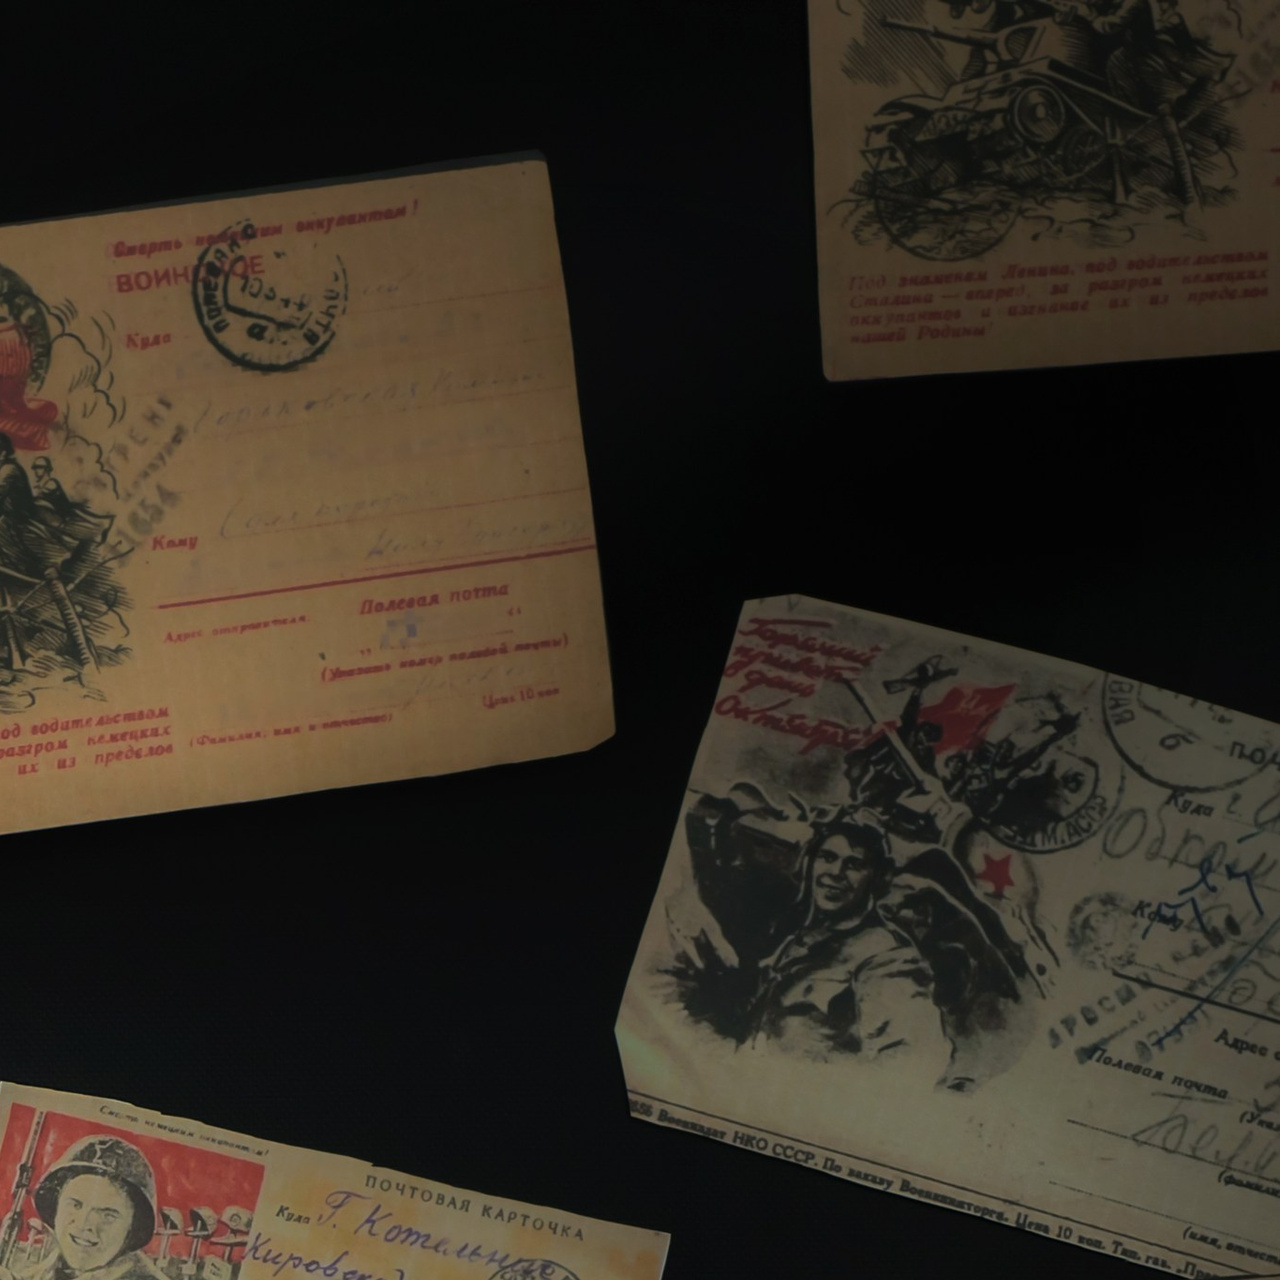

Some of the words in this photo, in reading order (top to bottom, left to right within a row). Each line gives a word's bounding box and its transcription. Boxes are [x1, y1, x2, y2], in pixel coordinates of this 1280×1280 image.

[116, 255, 265, 293] ВОИНОЕ
[359, 593, 440, 615] Полевая
[30, 707, 170, 736] водительством
[86, 725, 171, 746] немецких
[17, 762, 39, 776] их
[56, 756, 76, 770] из
[94, 743, 174, 767] пределов
[1163, 787, 1215, 817] Куда
[1213, 1028, 1269, 1058] Адрес
[1086, 1044, 1165, 1081] Полевая
[1171, 1075, 1229, 1100] почта
[732, 1130, 769, 1151] НКО
[770, 1142, 819, 1167] СССР.
[821, 1156, 843, 1174] По
[1013, 1212, 1050, 1237] Цена
[1055, 1225, 1073, 1240] 10
[364, 1174, 472, 1213] ПОЧТОВАЯ
[481, 1204, 584, 1242] КАРТОЧКА
